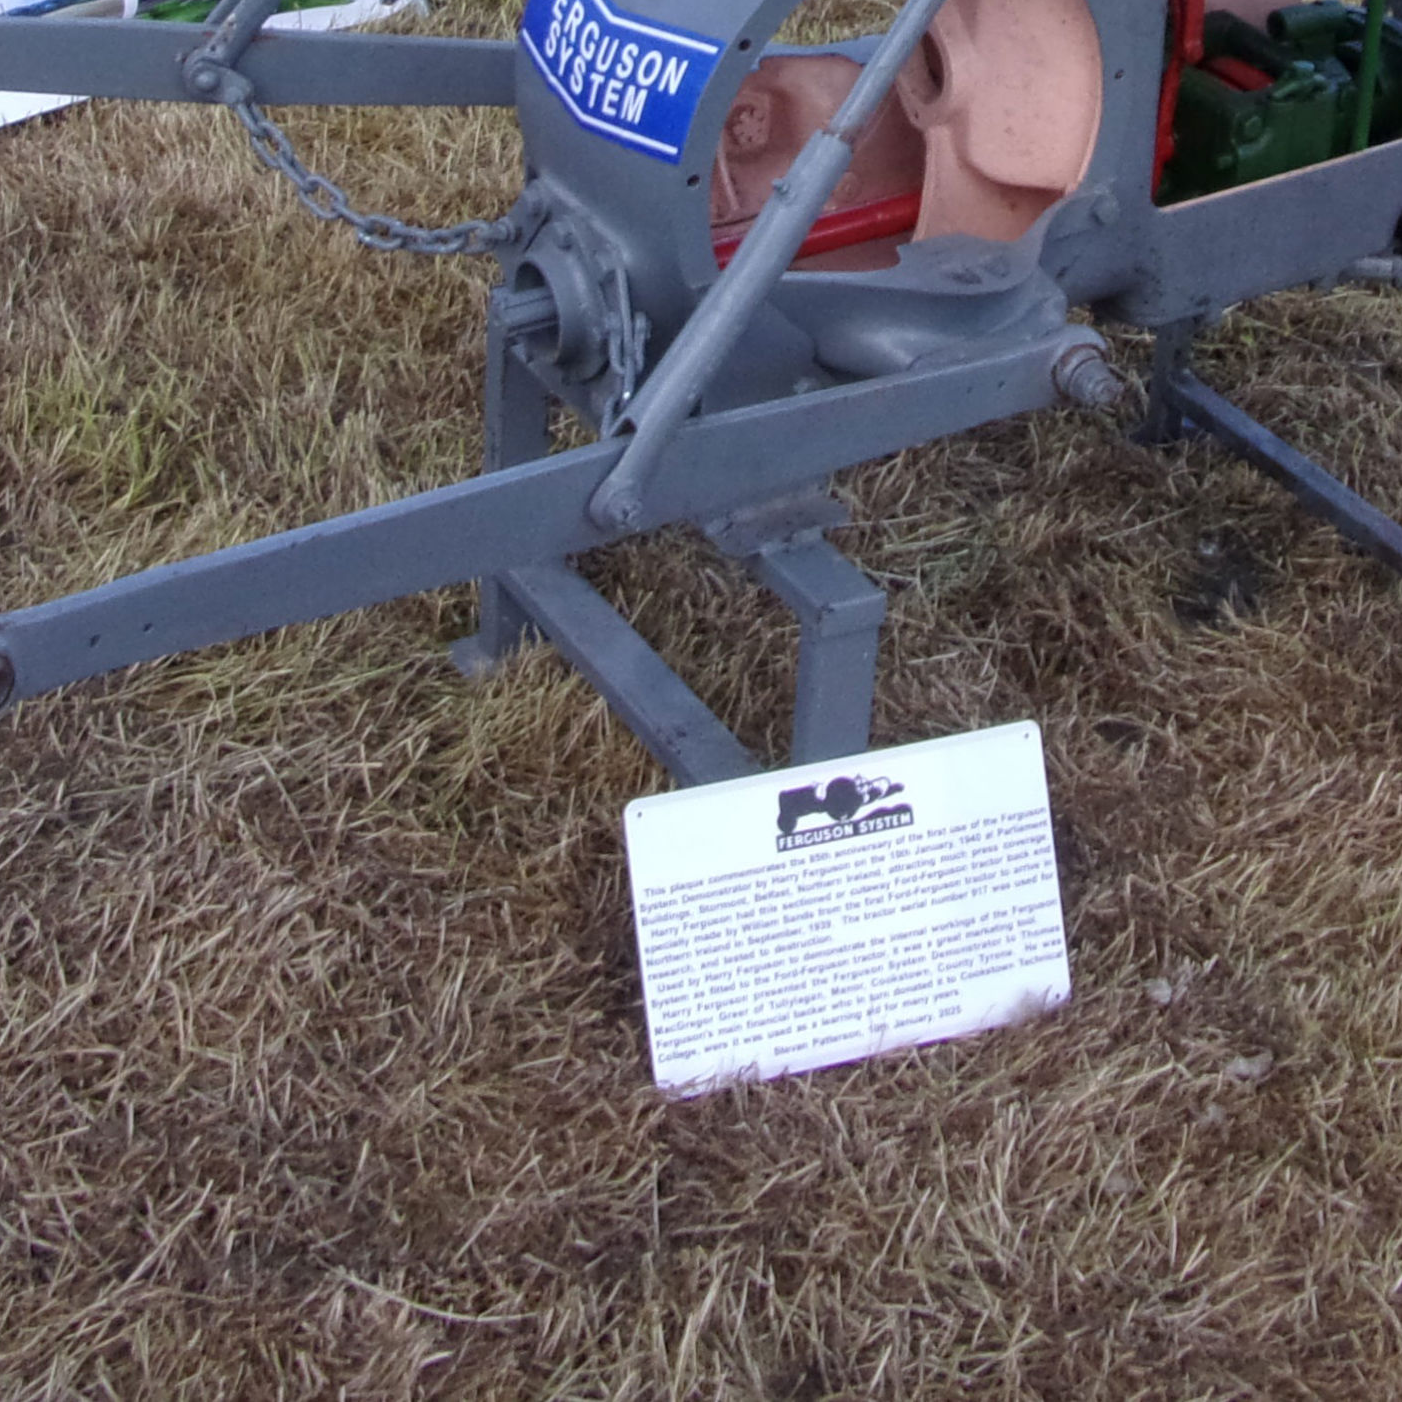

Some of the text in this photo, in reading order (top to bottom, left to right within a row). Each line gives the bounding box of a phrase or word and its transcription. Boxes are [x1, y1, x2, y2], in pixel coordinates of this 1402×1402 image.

[545, 20, 648, 125] SYSTEM
[778, 811, 911, 850] FERGUSON SYSTEM
